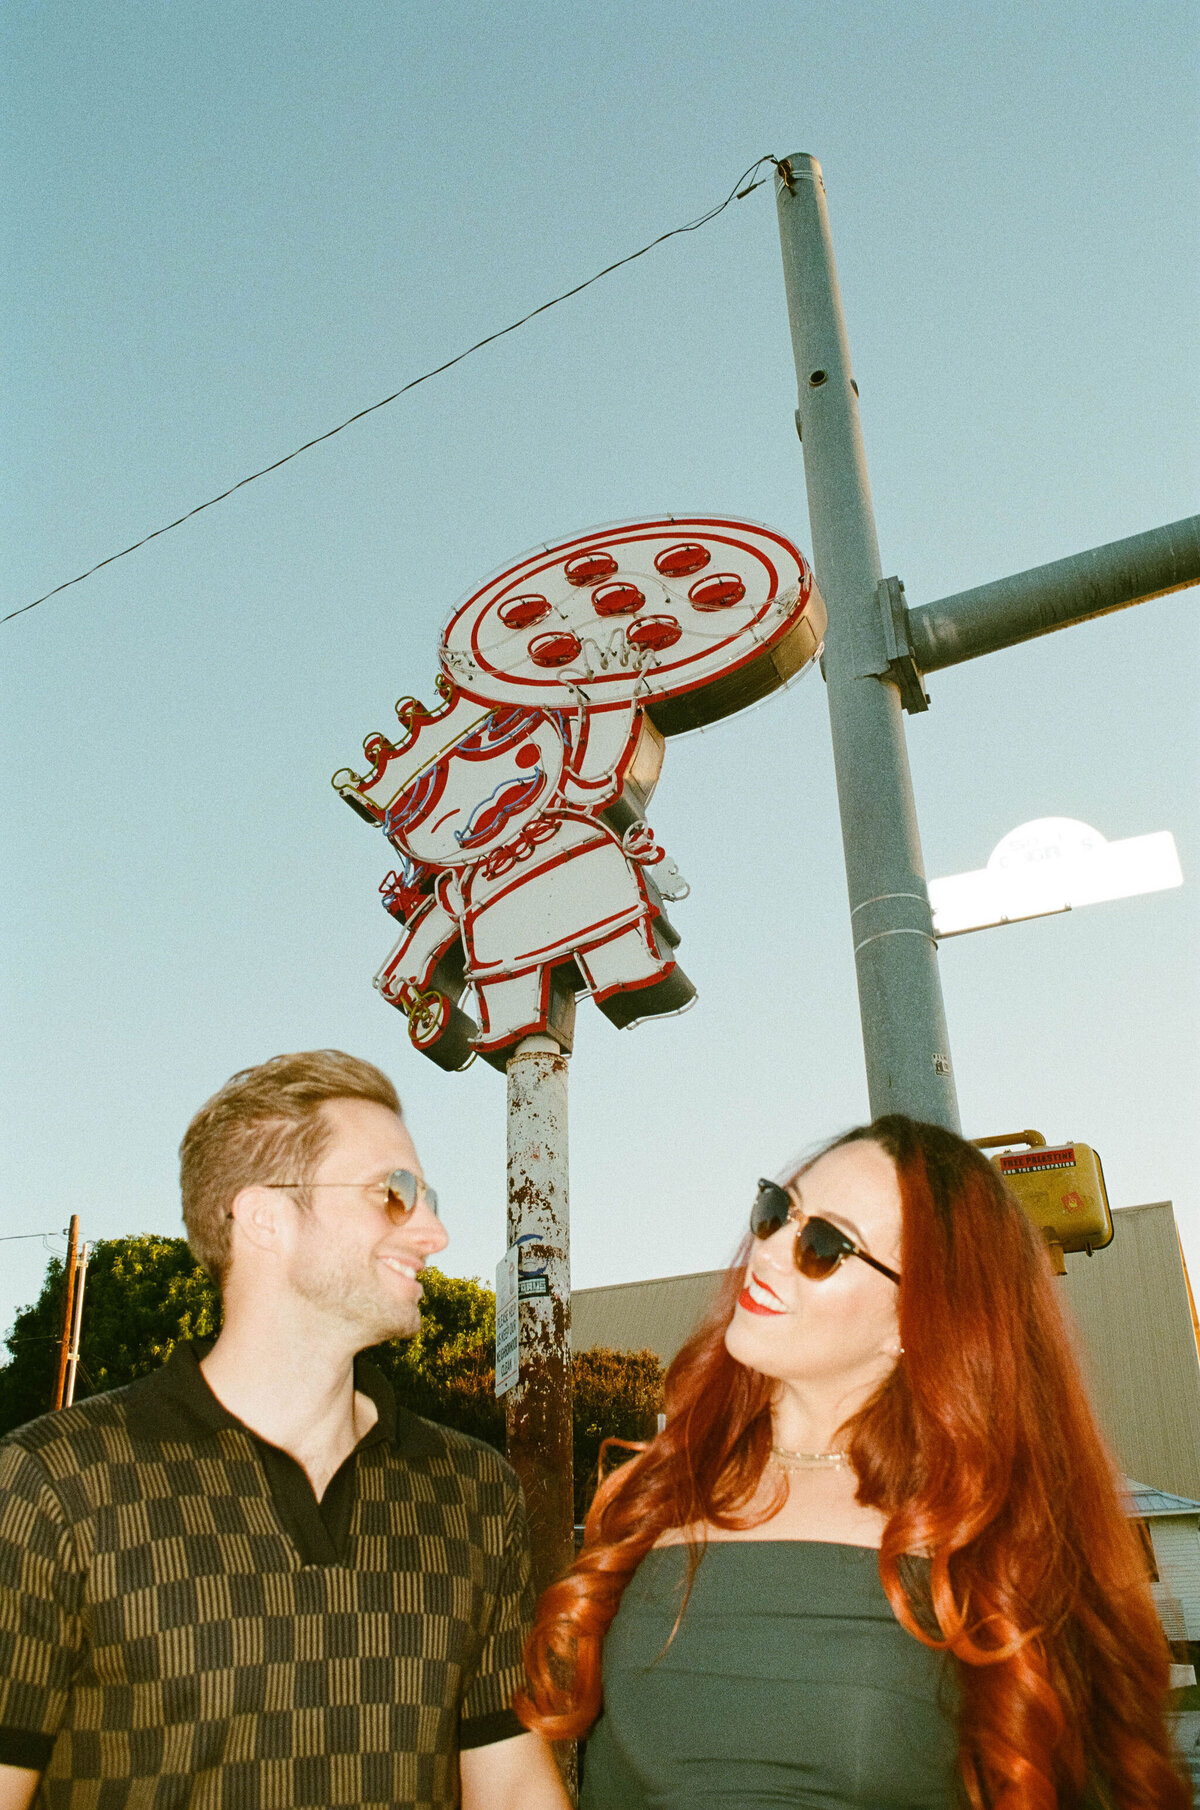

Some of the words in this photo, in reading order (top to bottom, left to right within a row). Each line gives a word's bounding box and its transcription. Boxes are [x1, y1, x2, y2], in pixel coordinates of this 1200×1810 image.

[1026, 1151, 1072, 1164] PALESTINE
[1032, 1161, 1075, 1171] OCCUPATION
[501, 1358, 512, 1377] CLEAN
